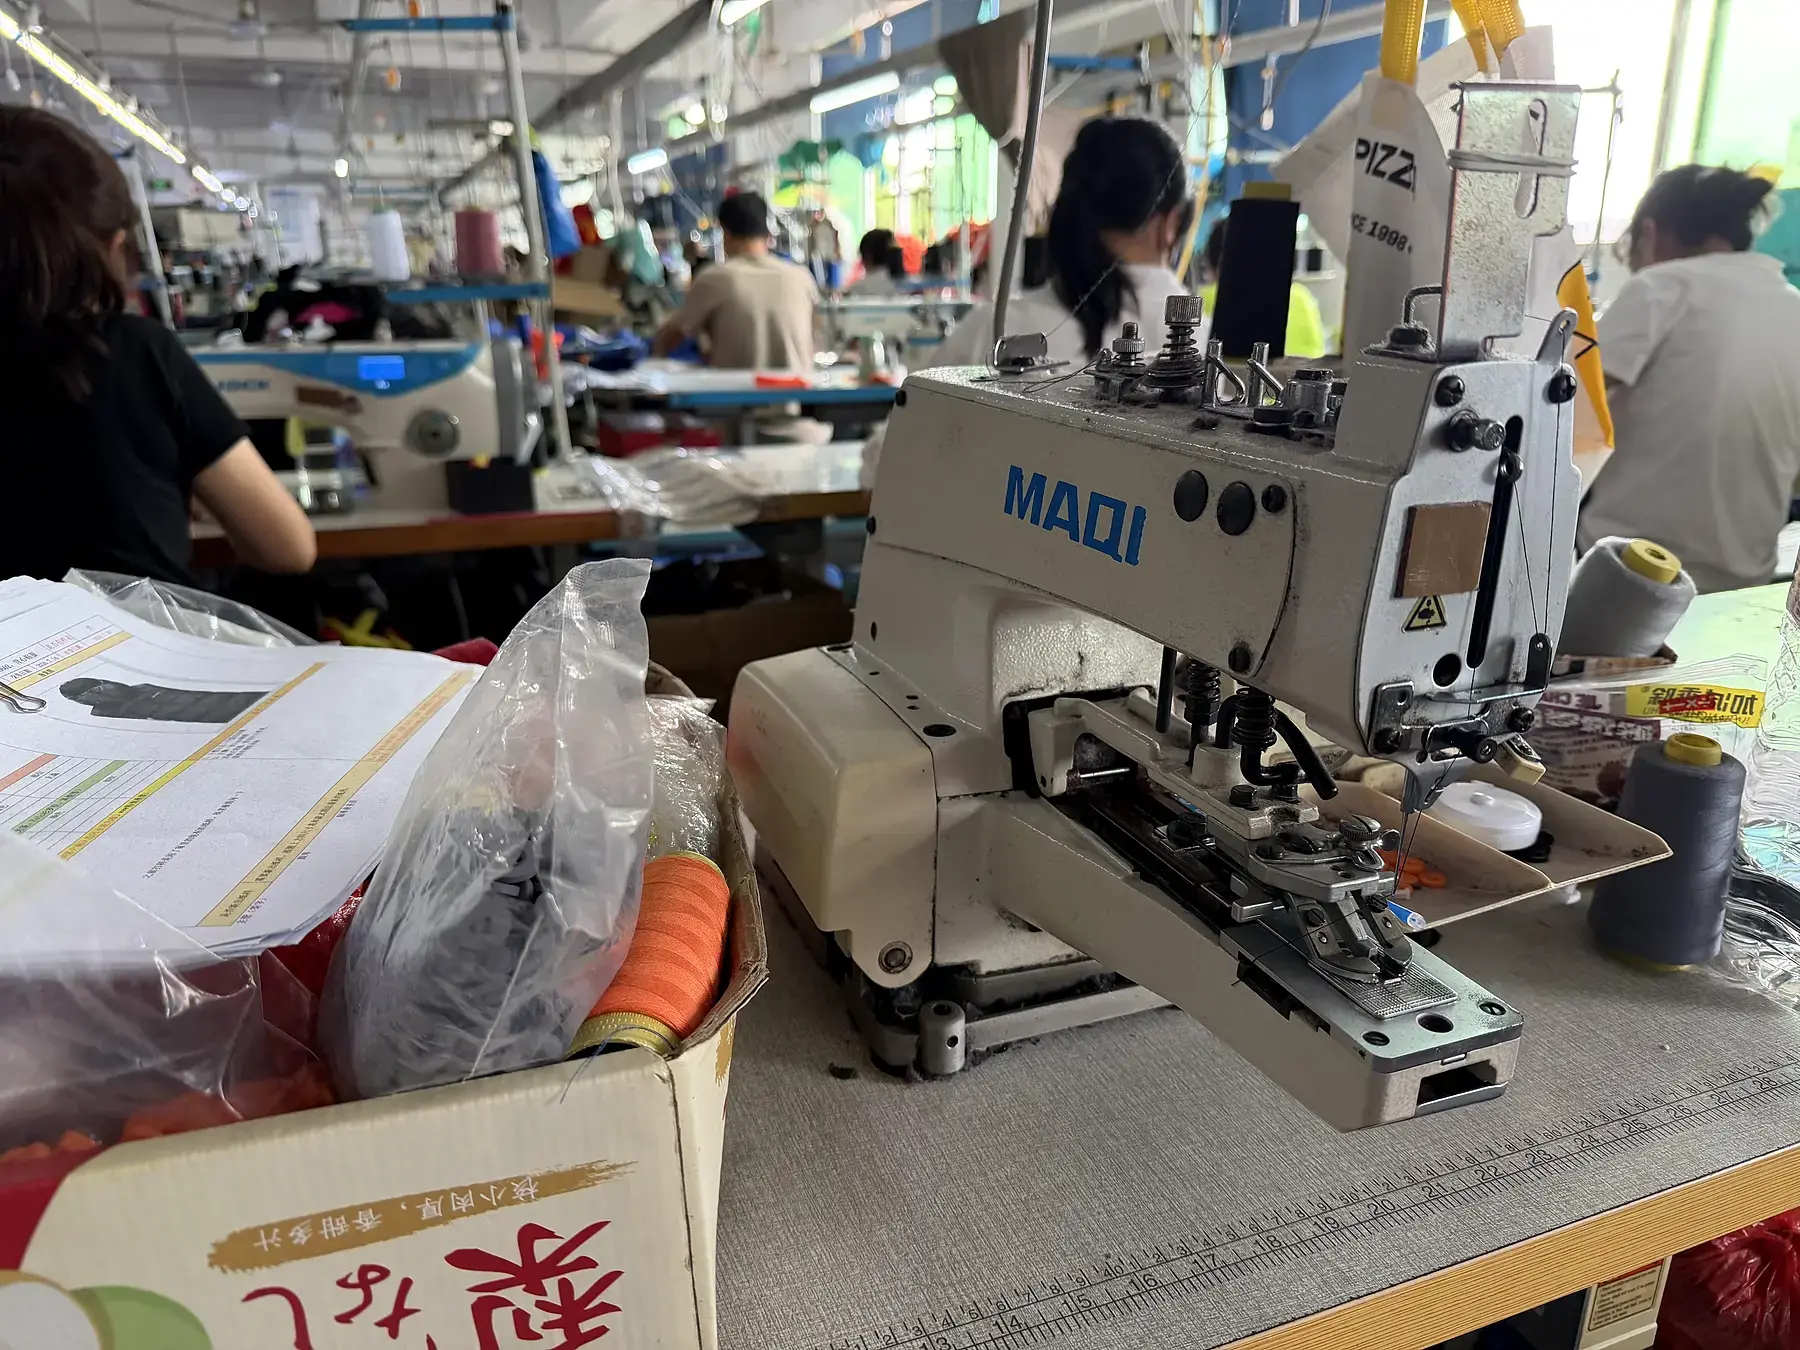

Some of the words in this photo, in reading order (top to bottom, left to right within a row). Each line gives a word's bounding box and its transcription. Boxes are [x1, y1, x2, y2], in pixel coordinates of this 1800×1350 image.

[1004, 464, 1147, 567] MAQI
[254, 1176, 539, 1252] 核小肉厚，香甜多汁
[882, 1334, 894, 1345] 2
[912, 1325, 923, 1337] 3
[941, 1317, 952, 1329] 4
[968, 1308, 979, 1320] 5
[996, 1300, 1007, 1311] 6
[1022, 1292, 1033, 1303] 7
[1049, 1284, 1060, 1295] 8
[1075, 1276, 1086, 1287] 9
[1103, 1265, 1124, 1278] 40
[1152, 1252, 1163, 1263] 2
[1176, 1245, 1187, 1256] 3
[1202, 1238, 1212, 1248] 4
[1225, 1230, 1236, 1240] 5
[1248, 1223, 1259, 1233] 6
[1270, 1216, 1280, 1226] 7
[1294, 1209, 1305, 1219] 8
[1316, 1202, 1328, 1212] 9
[1339, 1193, 1360, 1205] 50
[1381, 1182, 1393, 1191] 2
[1403, 1175, 1415, 1184] 3
[1426, 1168, 1436, 1177] 4
[1445, 1162, 1456, 1171] 5
[1465, 1156, 1476, 1165] 6
[1486, 1150, 1496, 1158] 7
[992, 1314, 1022, 1335] 14
[1061, 1293, 1092, 1313] 15
[1129, 1273, 1158, 1292] 16
[1192, 1253, 1218, 1272] 17
[1253, 1235, 1282, 1251] 18
[1313, 1216, 1340, 1232] 19
[1367, 1199, 1396, 1215] 20
[1422, 1182, 1449, 1198] 21
[1475, 1165, 1503, 1181] 22
[1525, 1149, 1553, 1165] 23
[1574, 1134, 1601, 1149] 24
[1621, 1119, 1648, 1134] 25
[1666, 1104, 1693, 1119] 26
[1710, 1090, 1735, 1104] 27
[1753, 1077, 1779, 1091] 28
